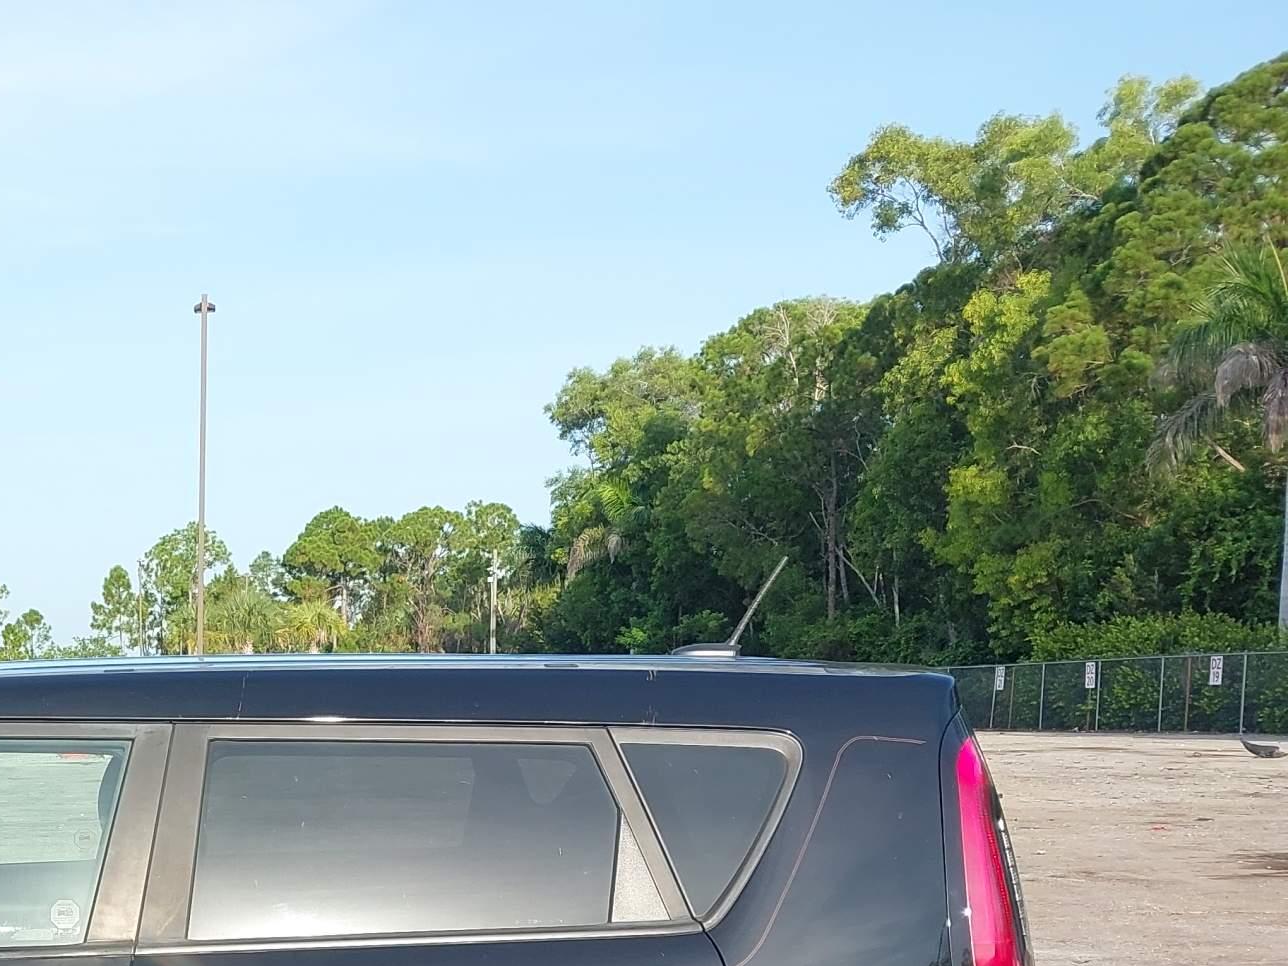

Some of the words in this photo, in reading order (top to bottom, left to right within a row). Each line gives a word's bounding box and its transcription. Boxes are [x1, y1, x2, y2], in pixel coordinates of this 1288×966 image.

[1086, 664, 1094, 675] DZ
[1211, 658, 1222, 670] DZ
[1086, 676, 1094, 687] 20
[1211, 671, 1220, 683] 19
